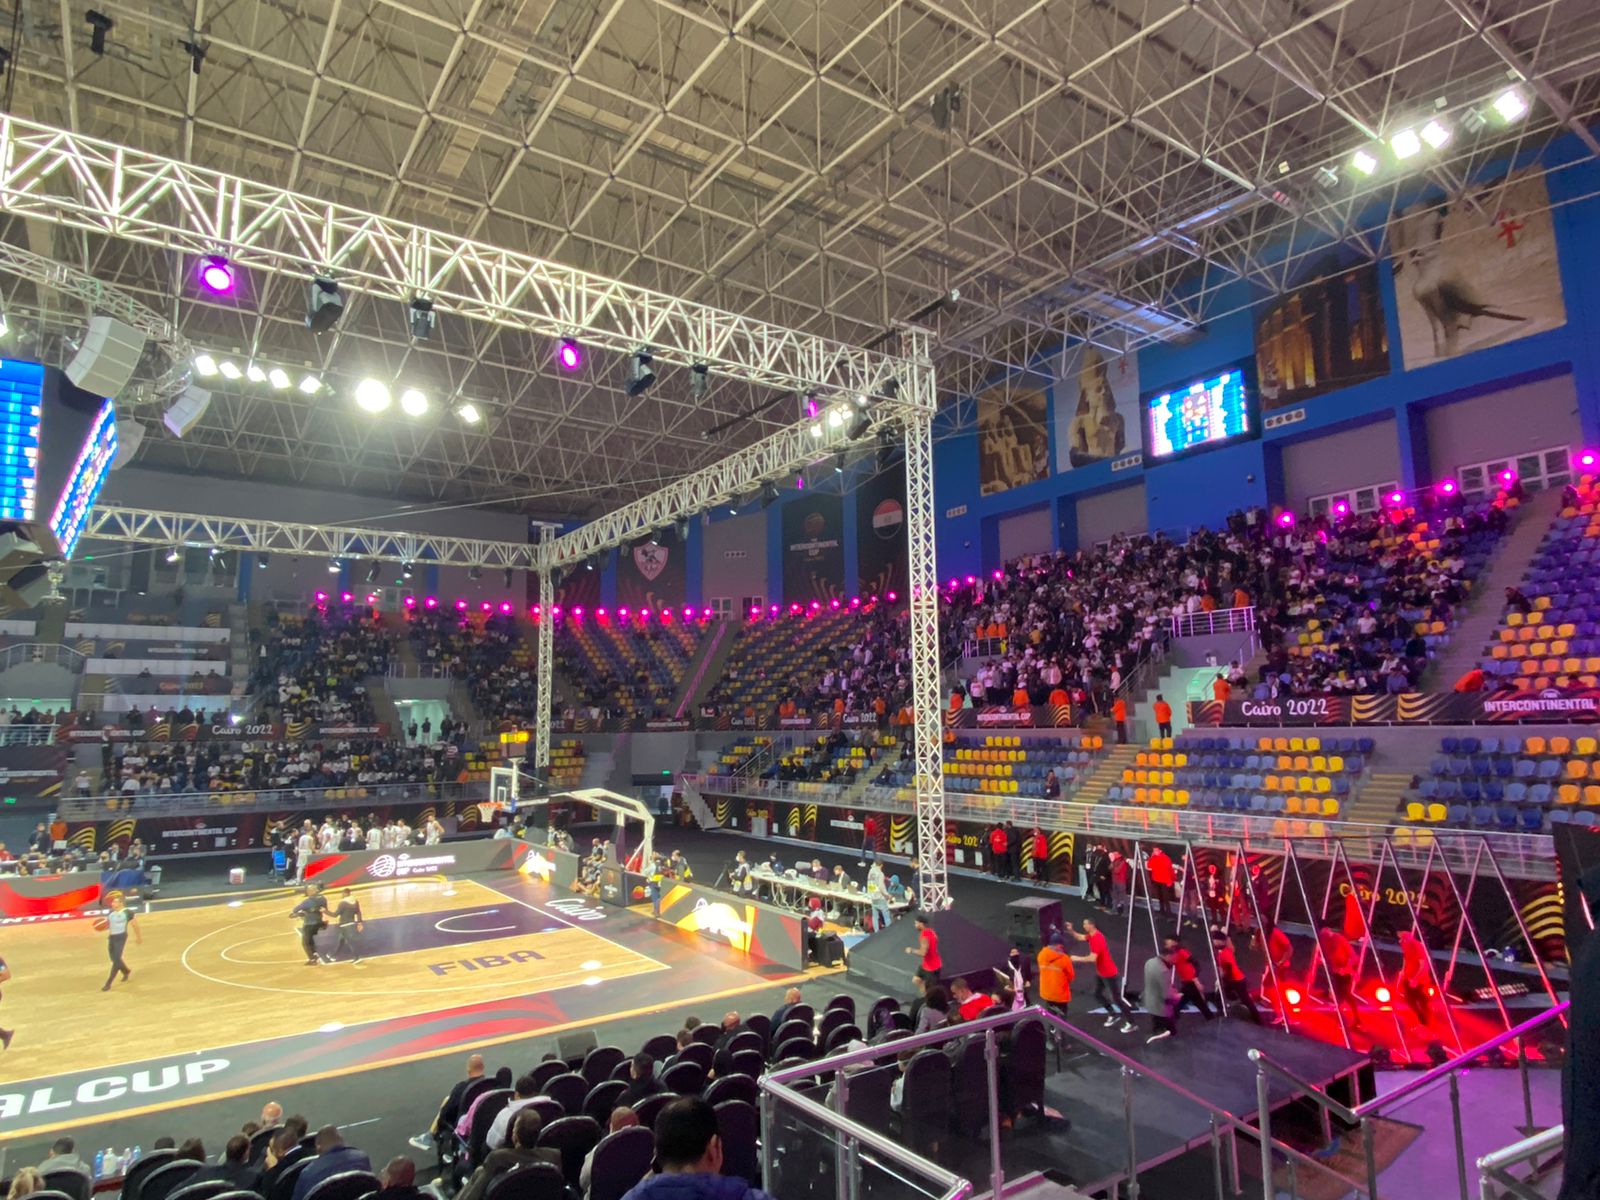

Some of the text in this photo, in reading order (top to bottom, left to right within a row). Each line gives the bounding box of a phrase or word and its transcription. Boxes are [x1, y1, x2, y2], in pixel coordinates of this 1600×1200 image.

[1241, 699, 1329, 716] Cairo 2022
[1484, 698, 1597, 712] INTERCONTINENTAL
[212, 724, 273, 735] Cairo 2022
[545, 898, 607, 920] Cairo
[427, 950, 546, 976] FIBA
